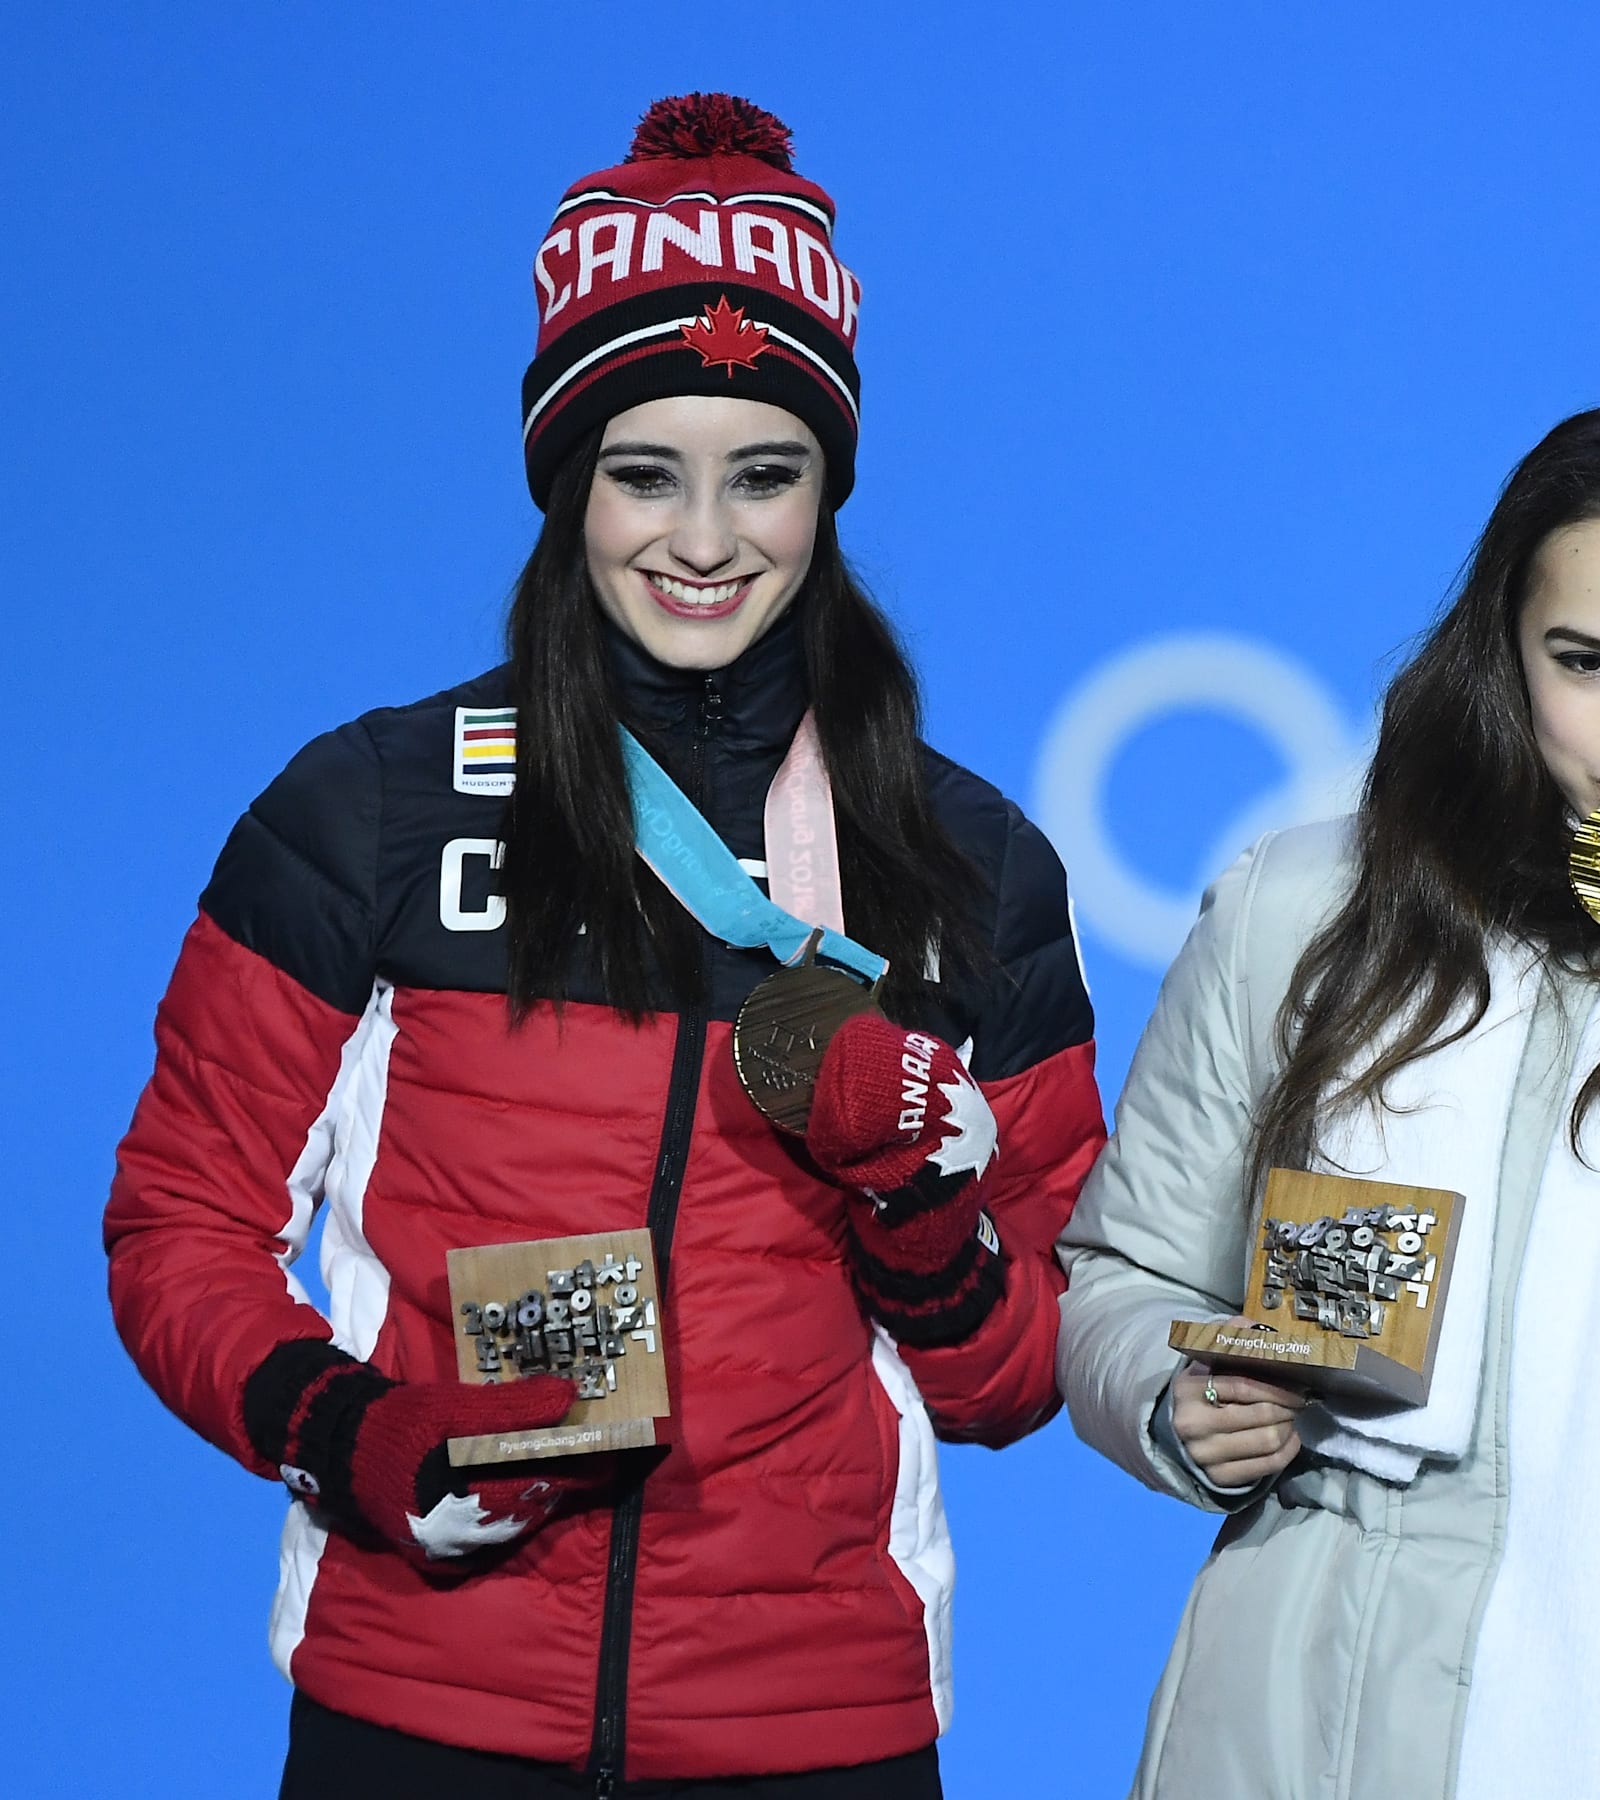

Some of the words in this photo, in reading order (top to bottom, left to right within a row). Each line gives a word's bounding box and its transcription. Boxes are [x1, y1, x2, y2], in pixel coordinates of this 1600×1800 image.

[1216, 1334, 1285, 1354] PyeongChang
[1286, 1342, 1311, 1355] 2018
[576, 1430, 602, 1444] 2018
